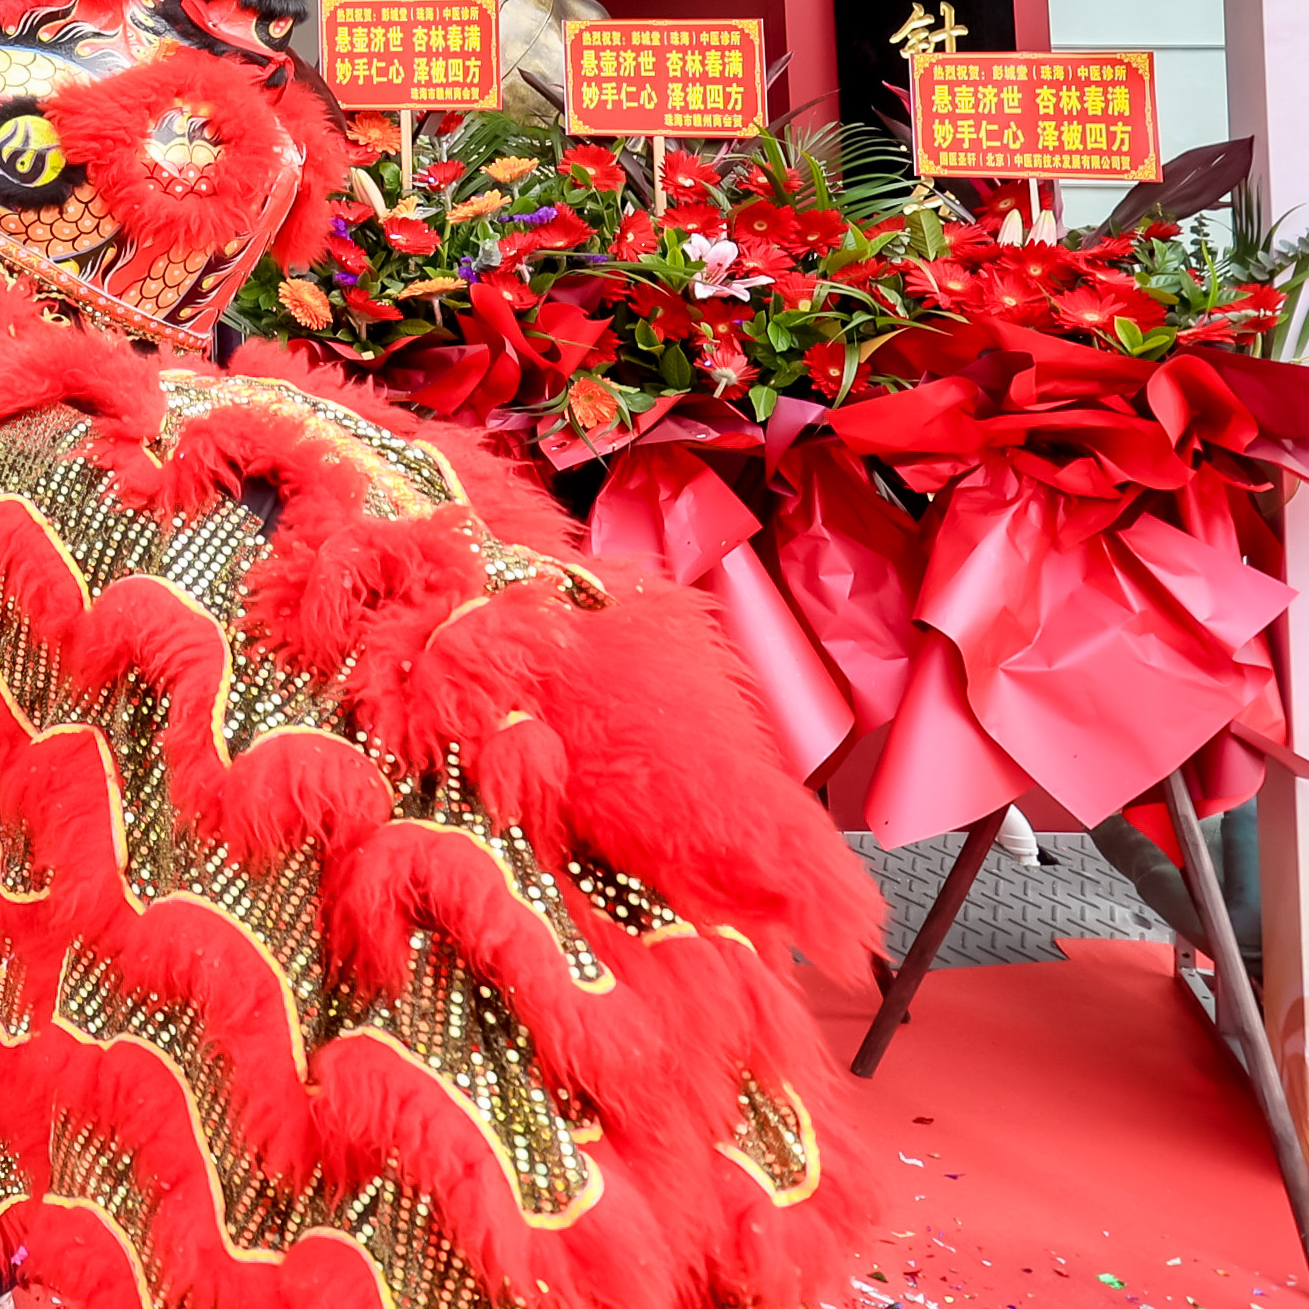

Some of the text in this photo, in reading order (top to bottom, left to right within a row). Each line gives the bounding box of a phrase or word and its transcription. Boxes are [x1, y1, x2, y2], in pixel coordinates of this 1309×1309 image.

[335, 24, 481, 53] 悬壶济世 杏林春满
[335, 56, 482, 85] 妙手仁心 泽被四方
[581, 49, 743, 79] 悬壶济世 杏林春满
[581, 82, 744, 111] 妙手仁心 泽被四方
[931, 84, 1130, 117] 悬壶济世 杏林春满
[932, 118, 1132, 152] 妙手仁心 泽被四方
